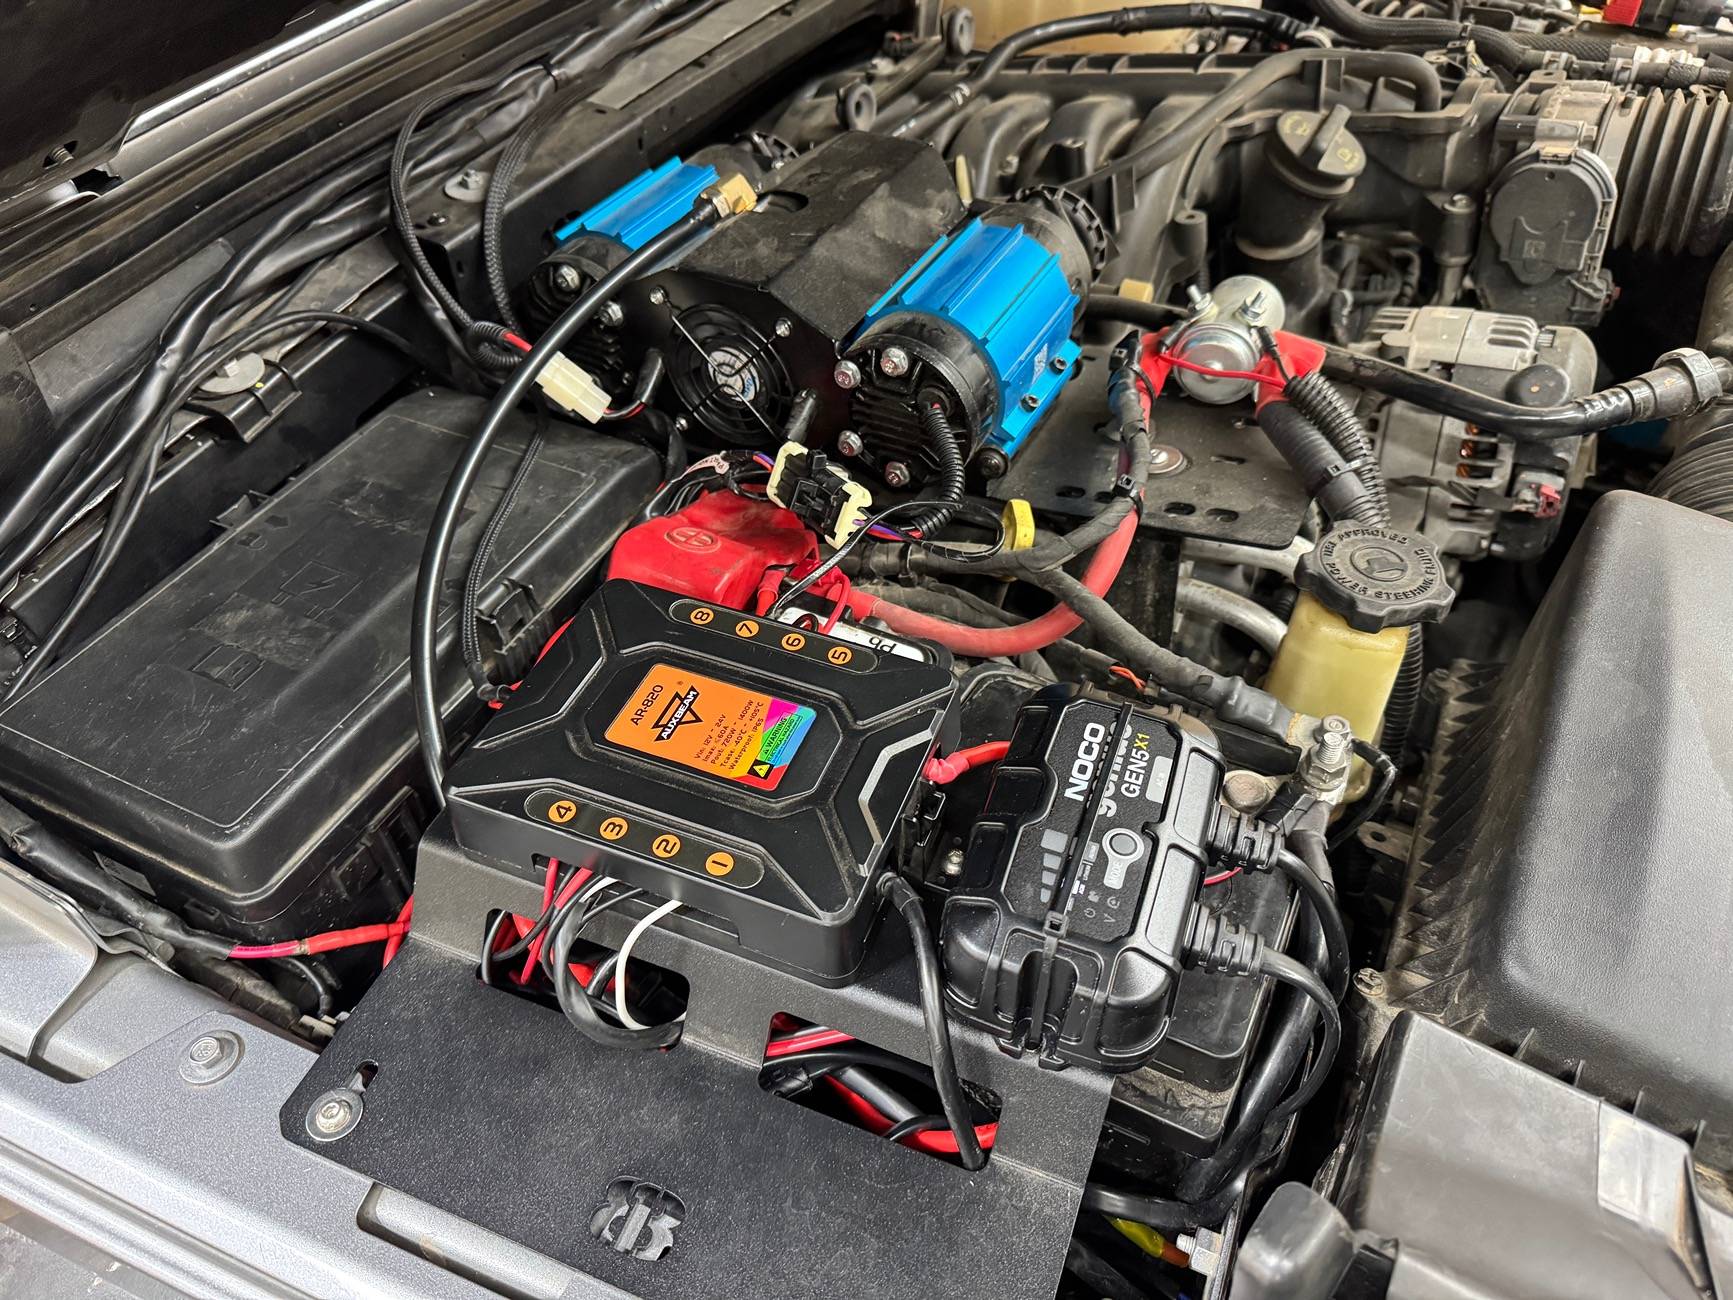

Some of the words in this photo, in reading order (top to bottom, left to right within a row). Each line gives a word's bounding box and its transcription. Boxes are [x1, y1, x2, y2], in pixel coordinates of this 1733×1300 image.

[1326, 562, 1368, 594] POWER
[1374, 577, 1434, 600] STEERING
[694, 610, 710, 622] 8
[738, 623, 753, 635] 7
[786, 636, 801, 648] 6
[868, 635, 897, 654] Pb
[831, 650, 848, 662] 5
[630, 684, 664, 726] AR-820
[660, 690, 698, 740] AUXBEAM
[715, 714, 726, 728] 24V
[722, 728, 736, 747] 720W
[738, 700, 754, 720] 1400W
[767, 717, 787, 747] WARNING
[1064, 722, 1105, 802] NOCO
[555, 804, 573, 819] 4
[603, 821, 624, 836] 3
[656, 838, 677, 854] 2
[1110, 861, 1123, 881] MODE
